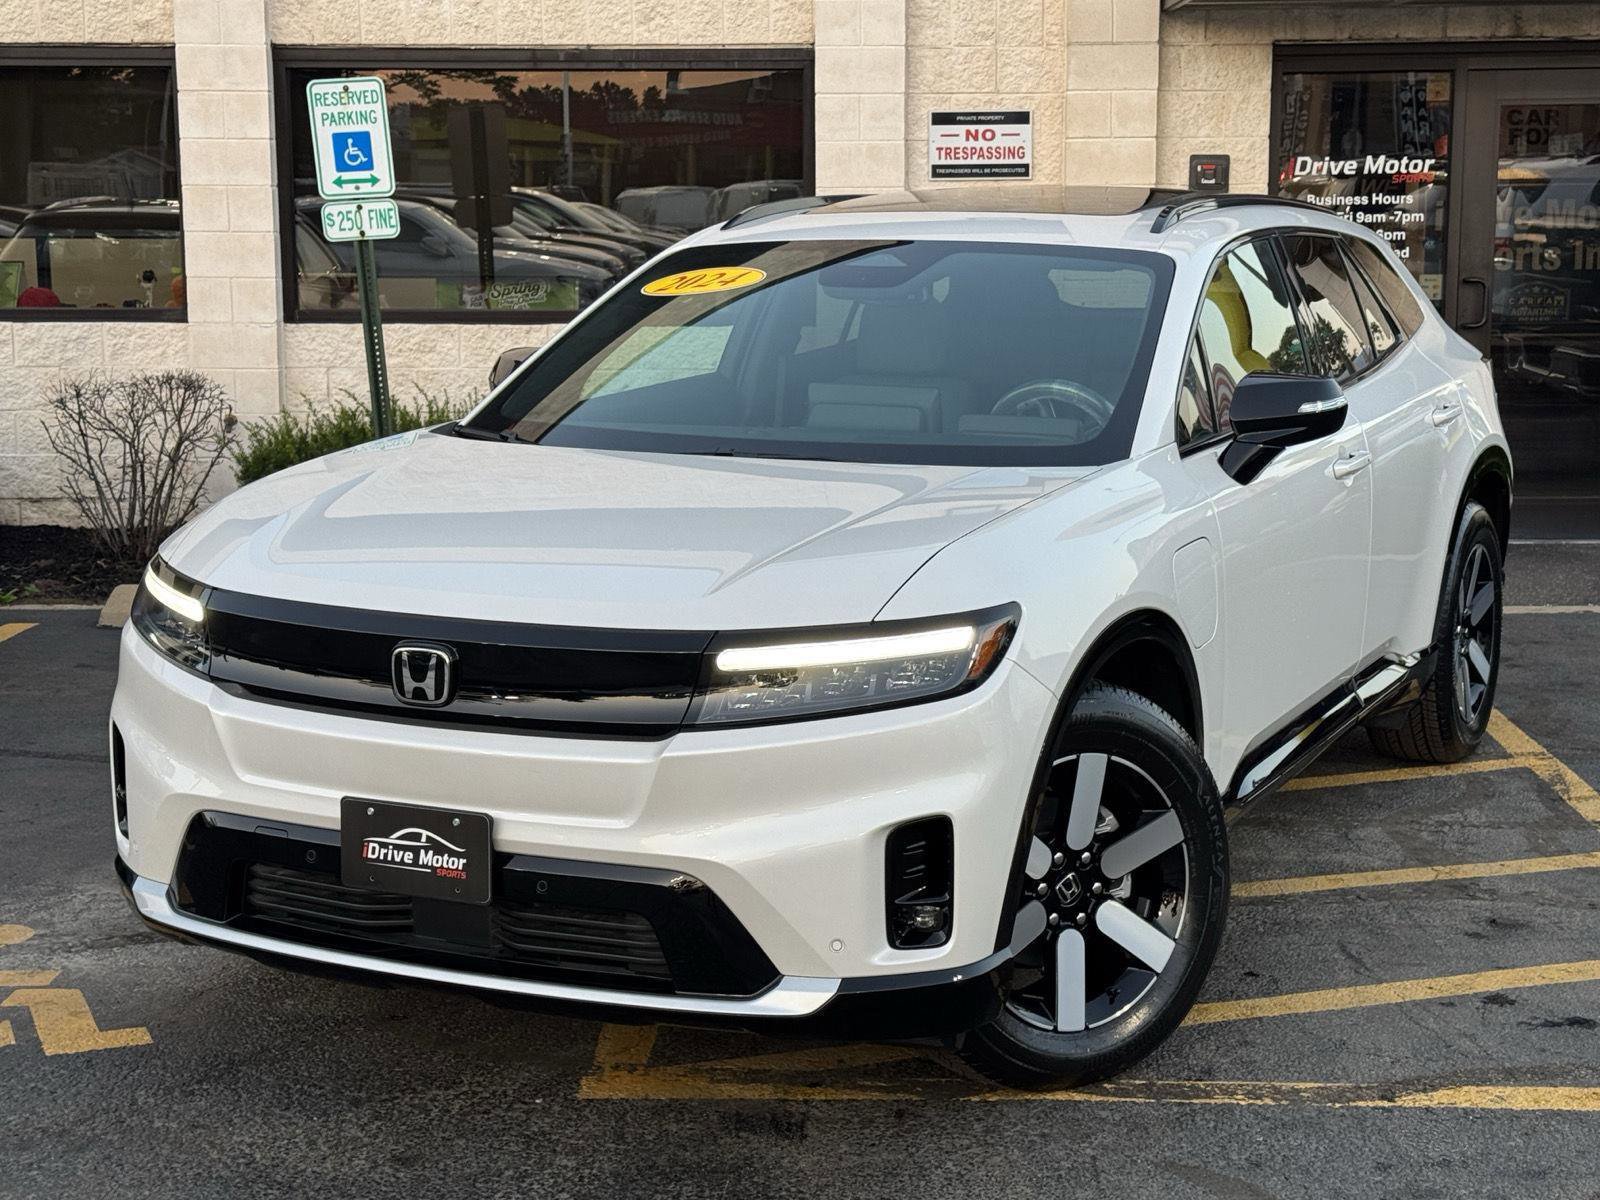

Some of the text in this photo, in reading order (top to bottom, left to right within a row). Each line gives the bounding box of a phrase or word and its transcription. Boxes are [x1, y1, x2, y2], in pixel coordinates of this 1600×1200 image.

[314, 89, 379, 107] RESERVED
[321, 109, 378, 127] PARKING
[965, 128, 996, 142] NO
[936, 145, 1026, 160] TRESPASSING
[1363, 155, 1435, 176] Motor
[1307, 192, 1413, 205] Business Hours
[367, 207, 396, 229] FINE
[1356, 211, 1386, 223] 9am
[491, 282, 541, 299] Spring
[651, 270, 753, 294] 2024
[362, 842, 467, 870] iDrive Motor
[436, 868, 467, 880] SPORTS
